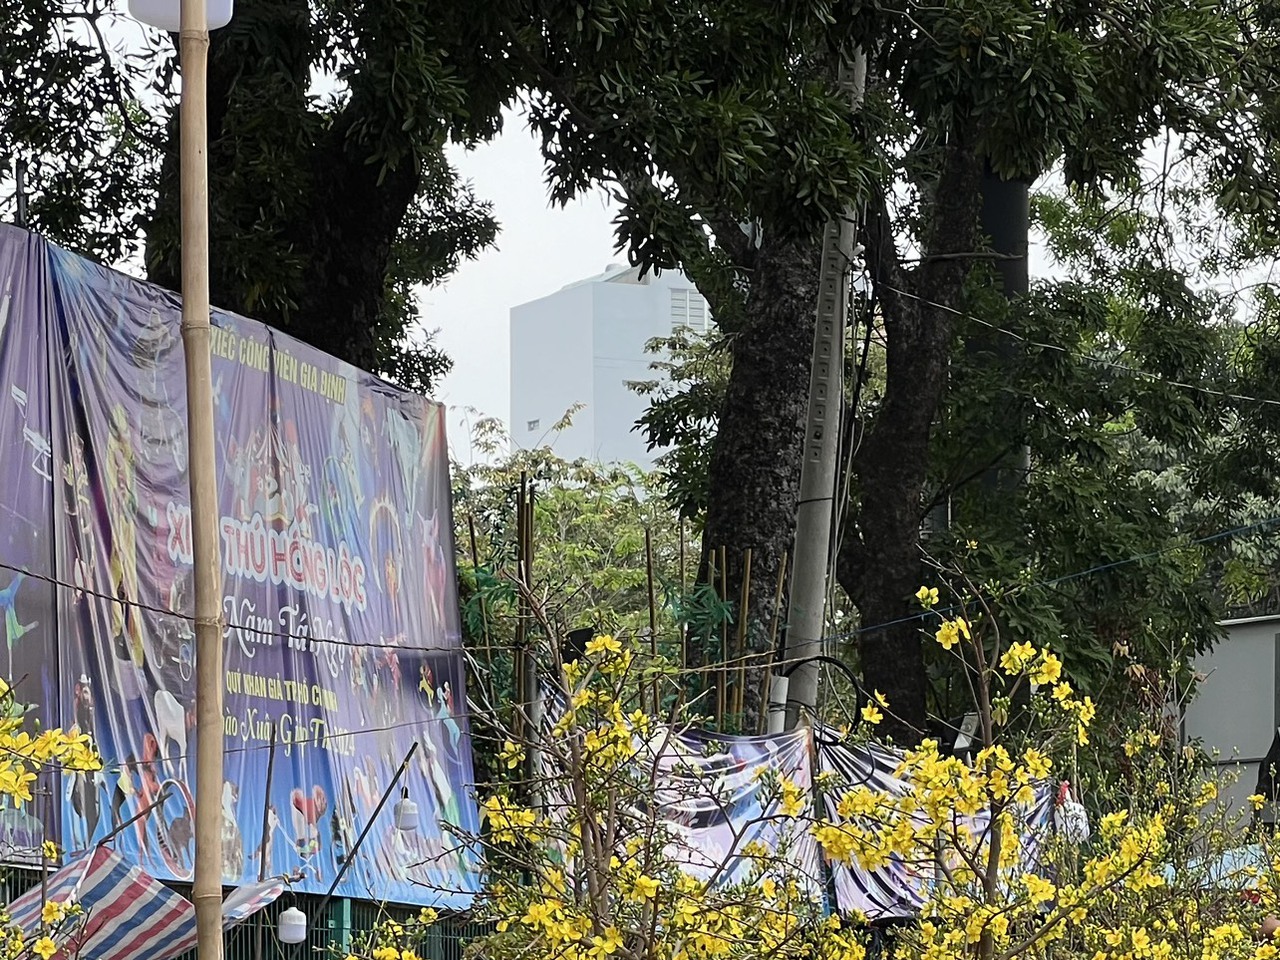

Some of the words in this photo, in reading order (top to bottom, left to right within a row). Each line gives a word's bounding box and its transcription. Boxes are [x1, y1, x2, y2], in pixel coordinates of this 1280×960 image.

[239, 336, 270, 373] CÔNG
[274, 349, 298, 385] VIÊN
[300, 361, 318, 393] GIA
[320, 370, 347, 406] ĐỊNH
